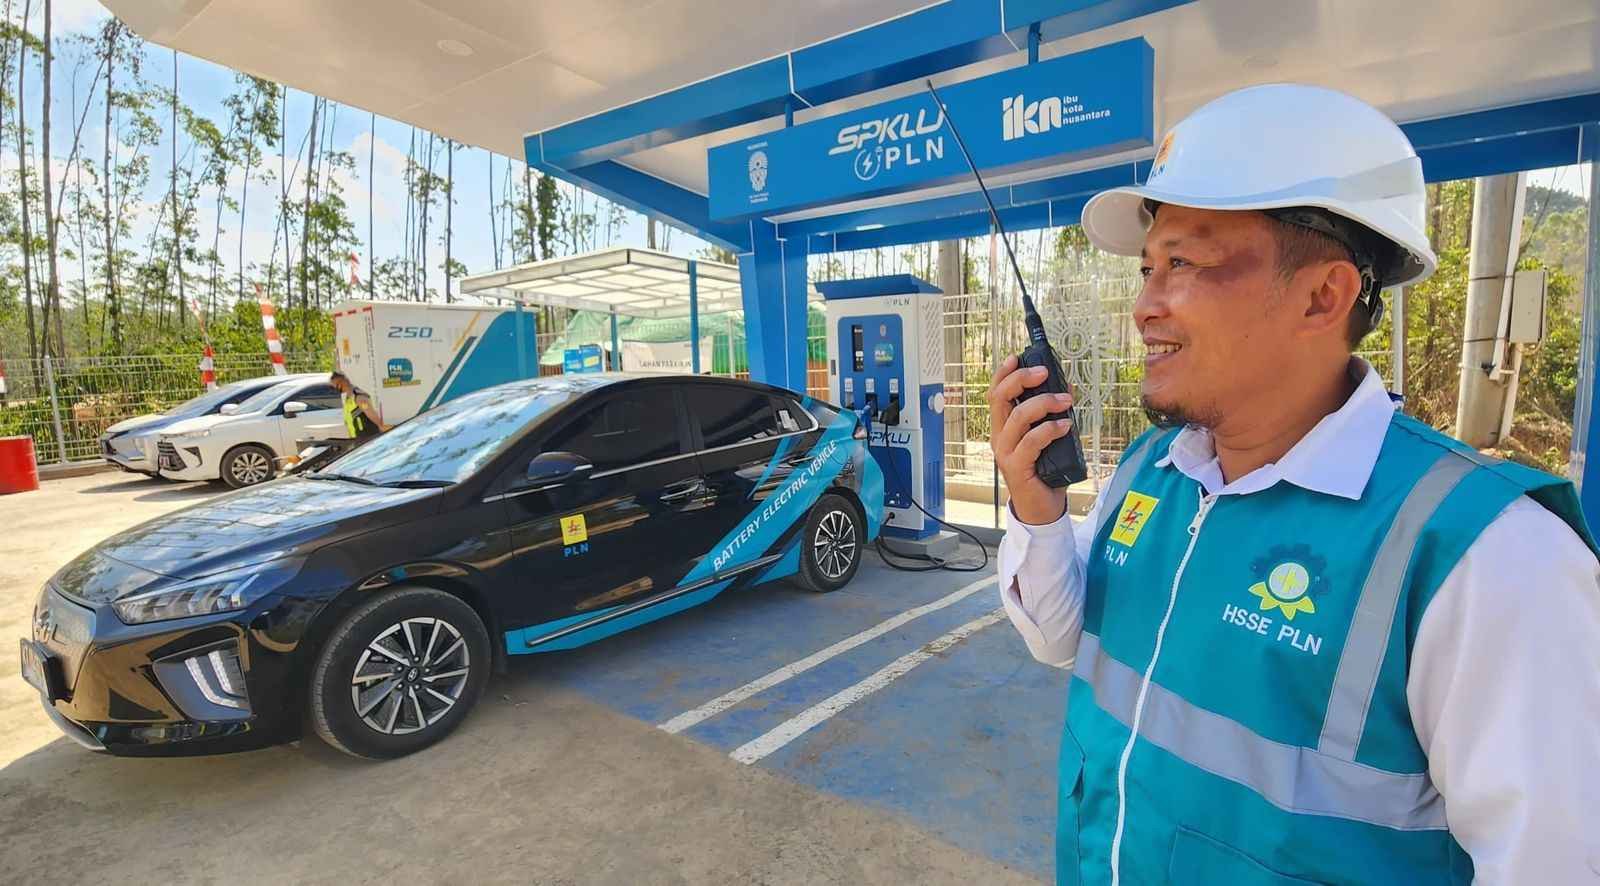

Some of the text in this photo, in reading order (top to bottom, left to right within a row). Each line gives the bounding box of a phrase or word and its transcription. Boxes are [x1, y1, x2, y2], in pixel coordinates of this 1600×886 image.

[1063, 96, 1078, 104] ibu
[1063, 104, 1083, 114] kota
[1002, 94, 1062, 141] ikn
[1063, 109, 1111, 125] nusantara
[828, 103, 947, 156] SPKLU
[885, 136, 944, 169] PLN
[387, 326, 433, 339] 250
[713, 440, 837, 571] BATTERY ELECTRIC VEHICLE
[564, 543, 589, 557] PLN
[1104, 544, 1129, 567] PLN
[1222, 603, 1322, 656] HSSE PLN
